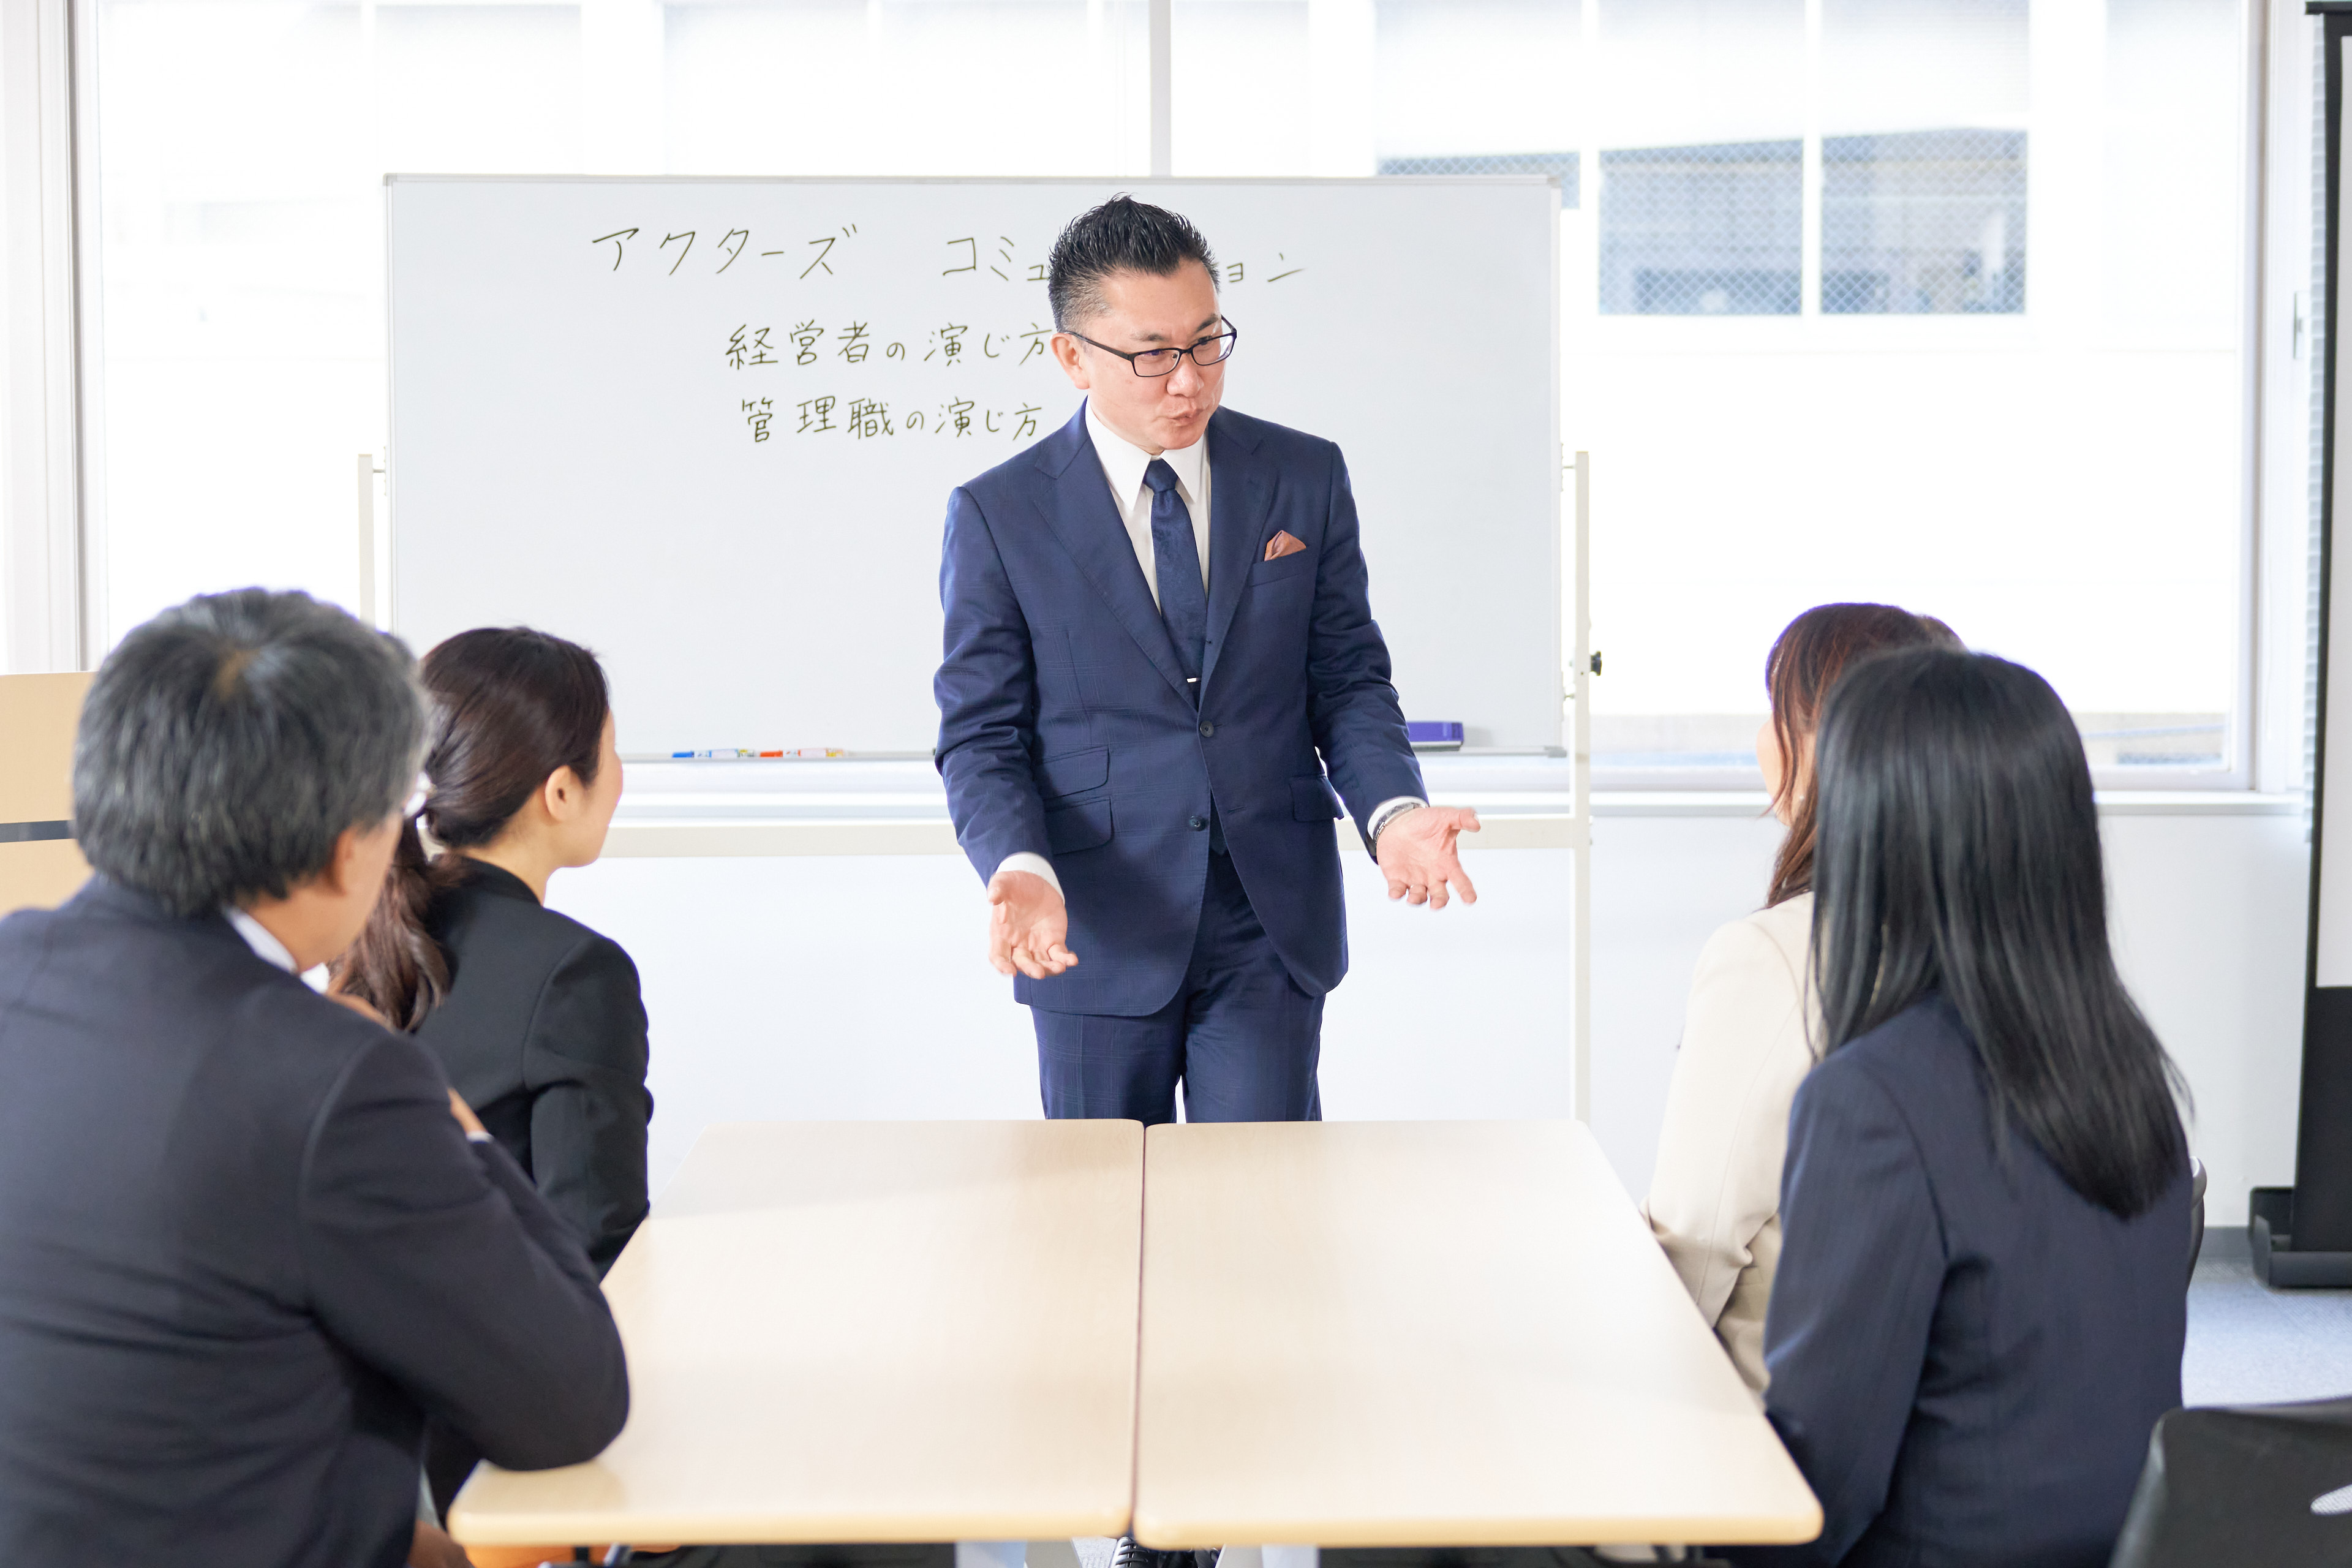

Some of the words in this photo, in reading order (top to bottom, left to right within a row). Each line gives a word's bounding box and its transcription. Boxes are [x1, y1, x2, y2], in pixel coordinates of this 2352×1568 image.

[592, 223, 858, 279] アクターズ
[725, 318, 1053, 371] 経営者の演じ方
[741, 395, 1043, 443] 管理職の演じ方
